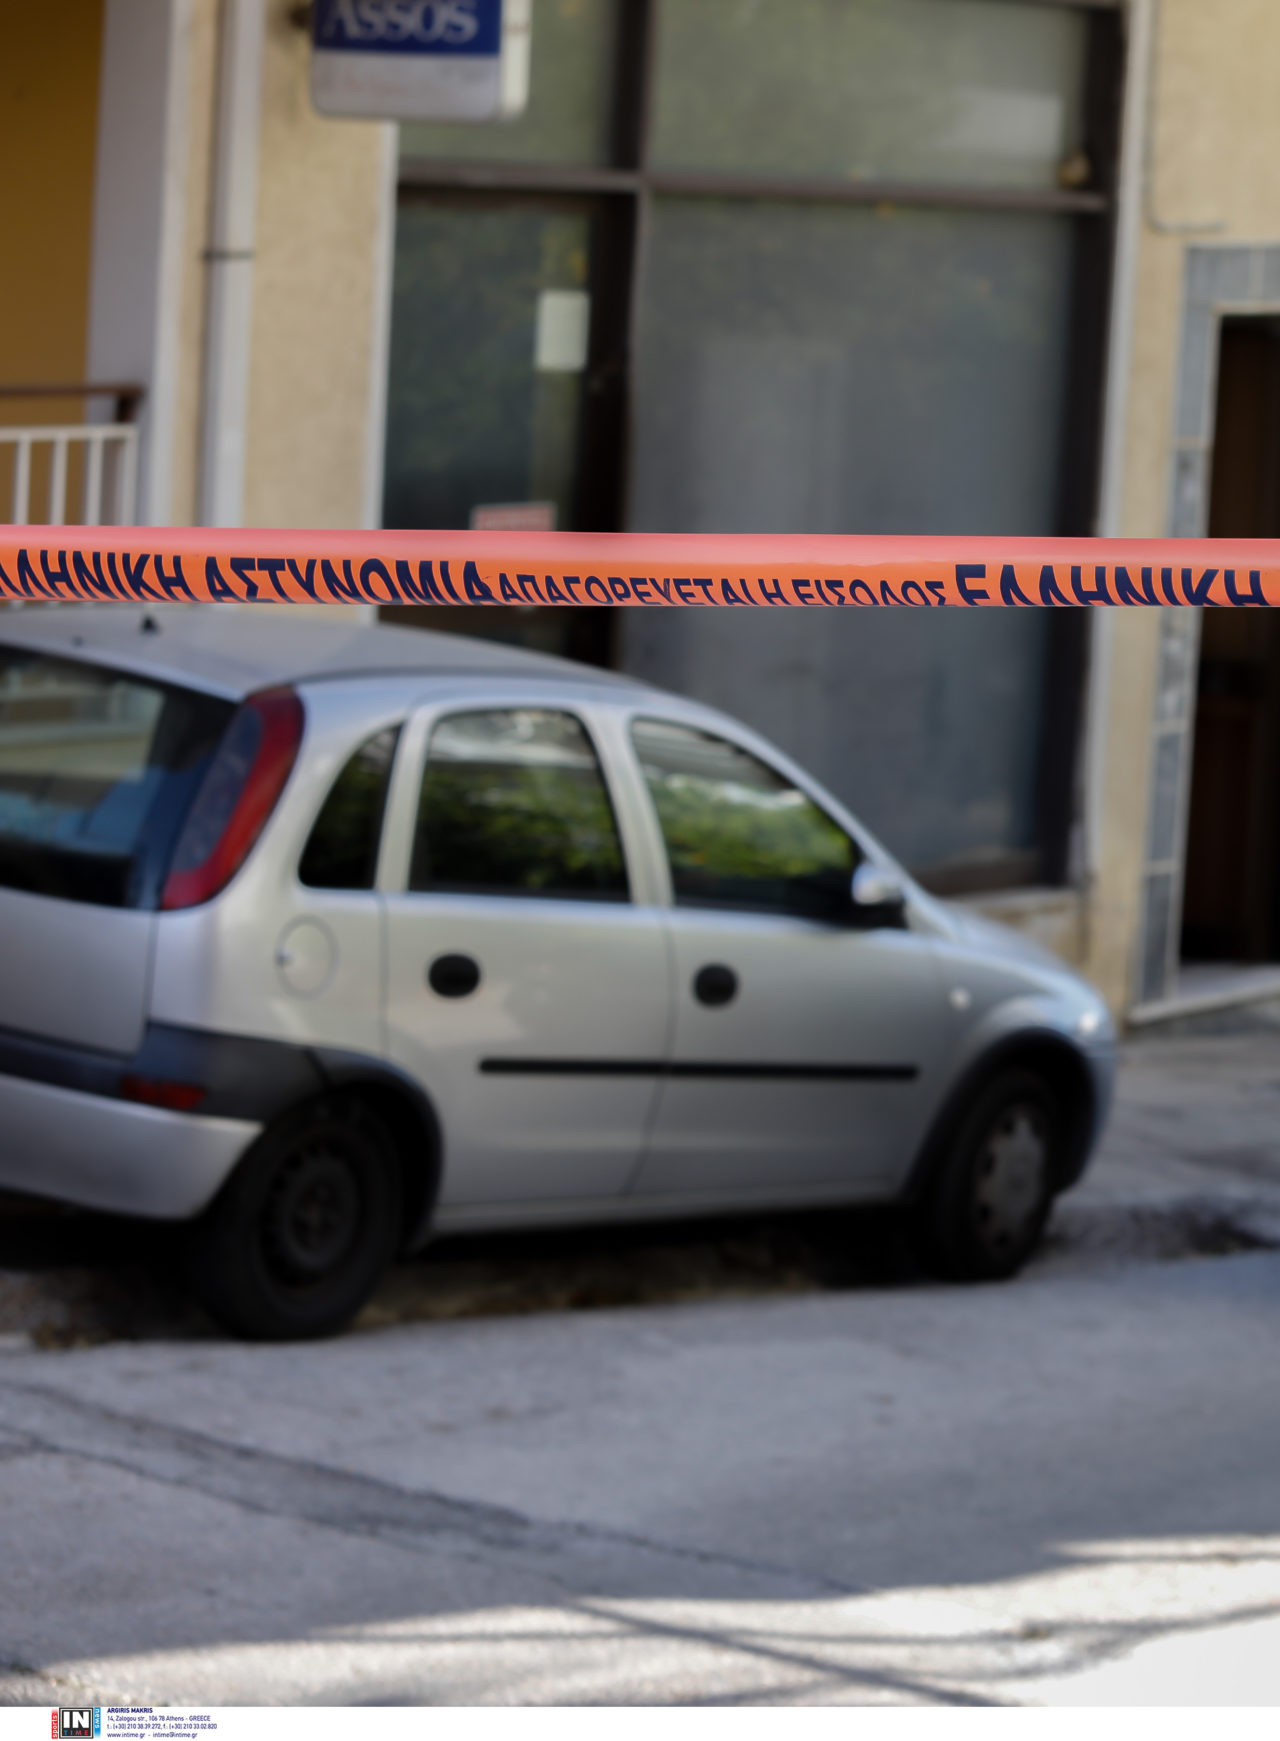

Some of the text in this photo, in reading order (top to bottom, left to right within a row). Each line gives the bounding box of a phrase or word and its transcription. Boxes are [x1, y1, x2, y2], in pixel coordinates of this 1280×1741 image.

[322, 0, 479, 44] ASSOS
[205, 556, 502, 605] ΑΣΤΥΝΟΜΙΑ
[499, 573, 758, 605] ΑΠΑΓΟΡΕΥΕΤΑΙ
